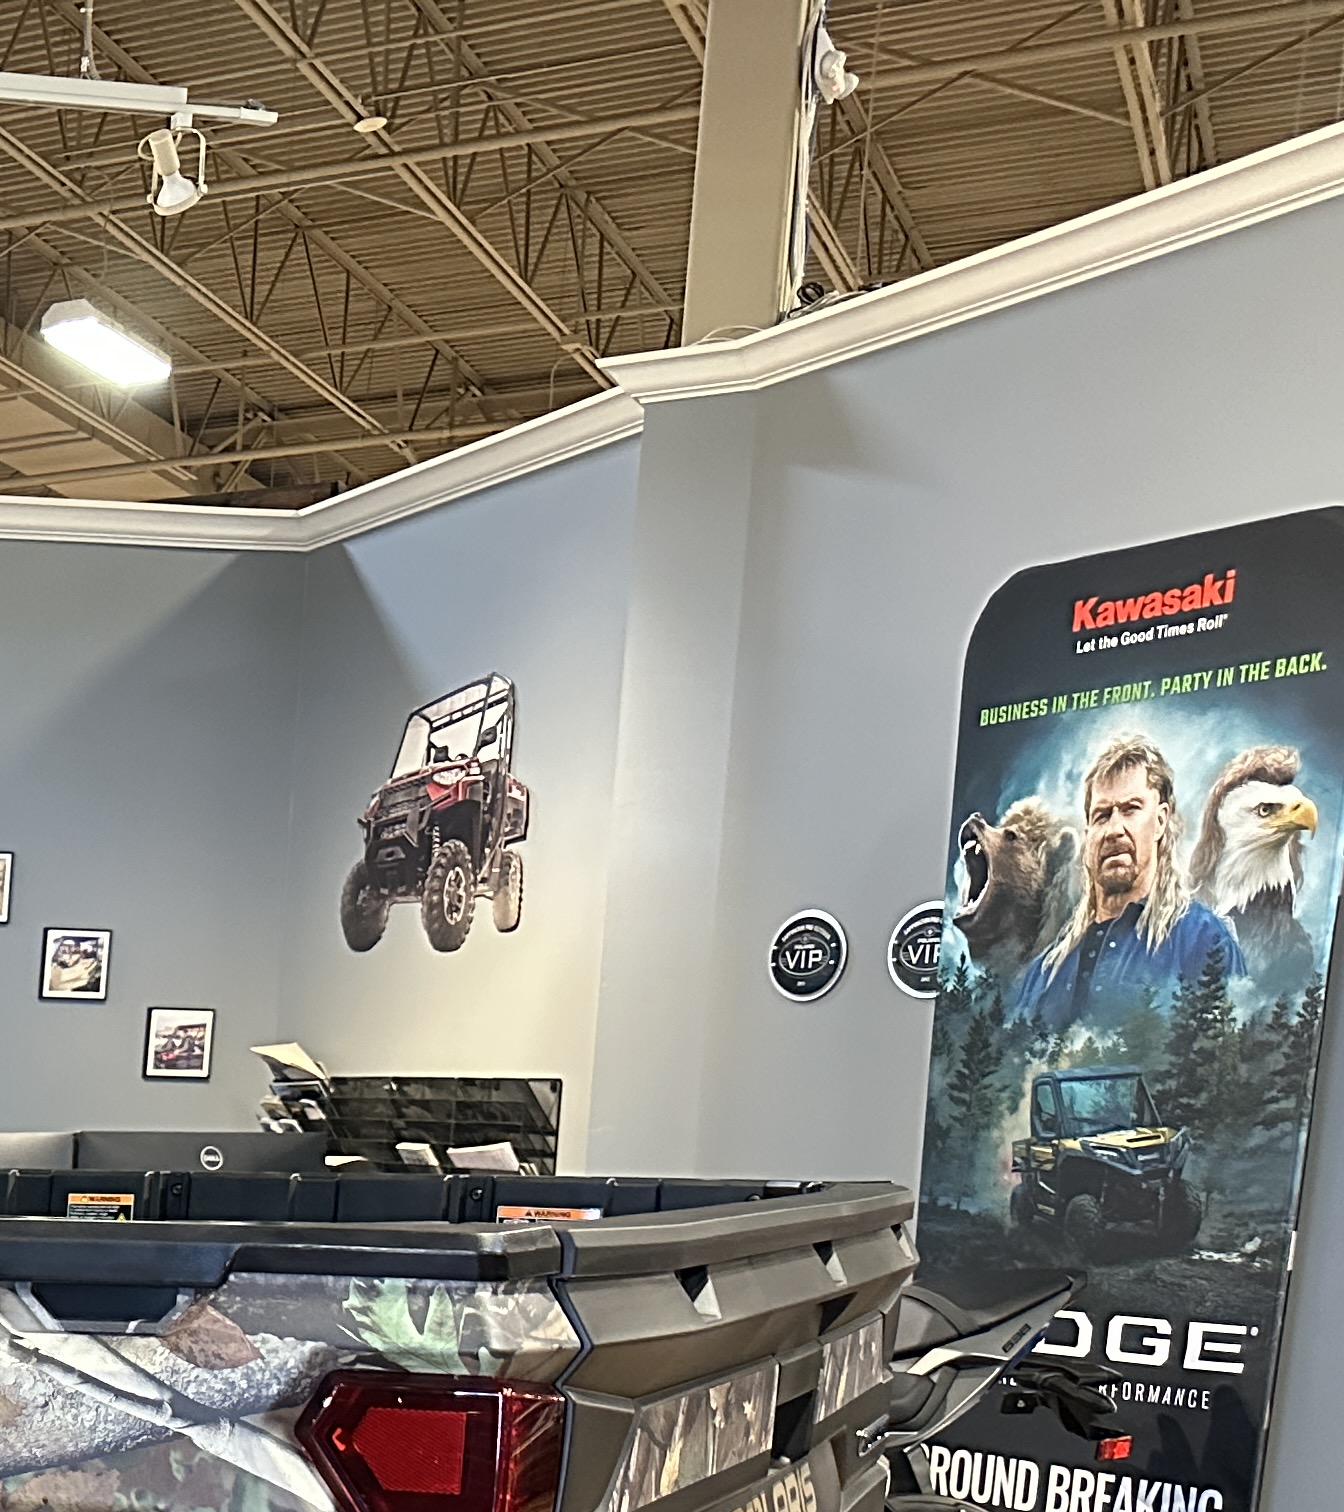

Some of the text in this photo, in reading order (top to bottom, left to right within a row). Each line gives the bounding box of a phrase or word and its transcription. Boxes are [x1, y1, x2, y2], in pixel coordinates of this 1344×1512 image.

[1071, 569, 1237, 633] Kawasaki
[1075, 638, 1095, 654] Let
[1098, 635, 1118, 649] the
[1120, 627, 1154, 646] Good
[1157, 622, 1195, 639] Times
[980, 651, 1328, 727] BUSINESS IN THE FRONT. PARTY IN THE BACK.
[785, 949, 823, 971] VIP
[1031, 1309, 1247, 1374] DGE
[921, 1444, 1040, 1512] ROUND
